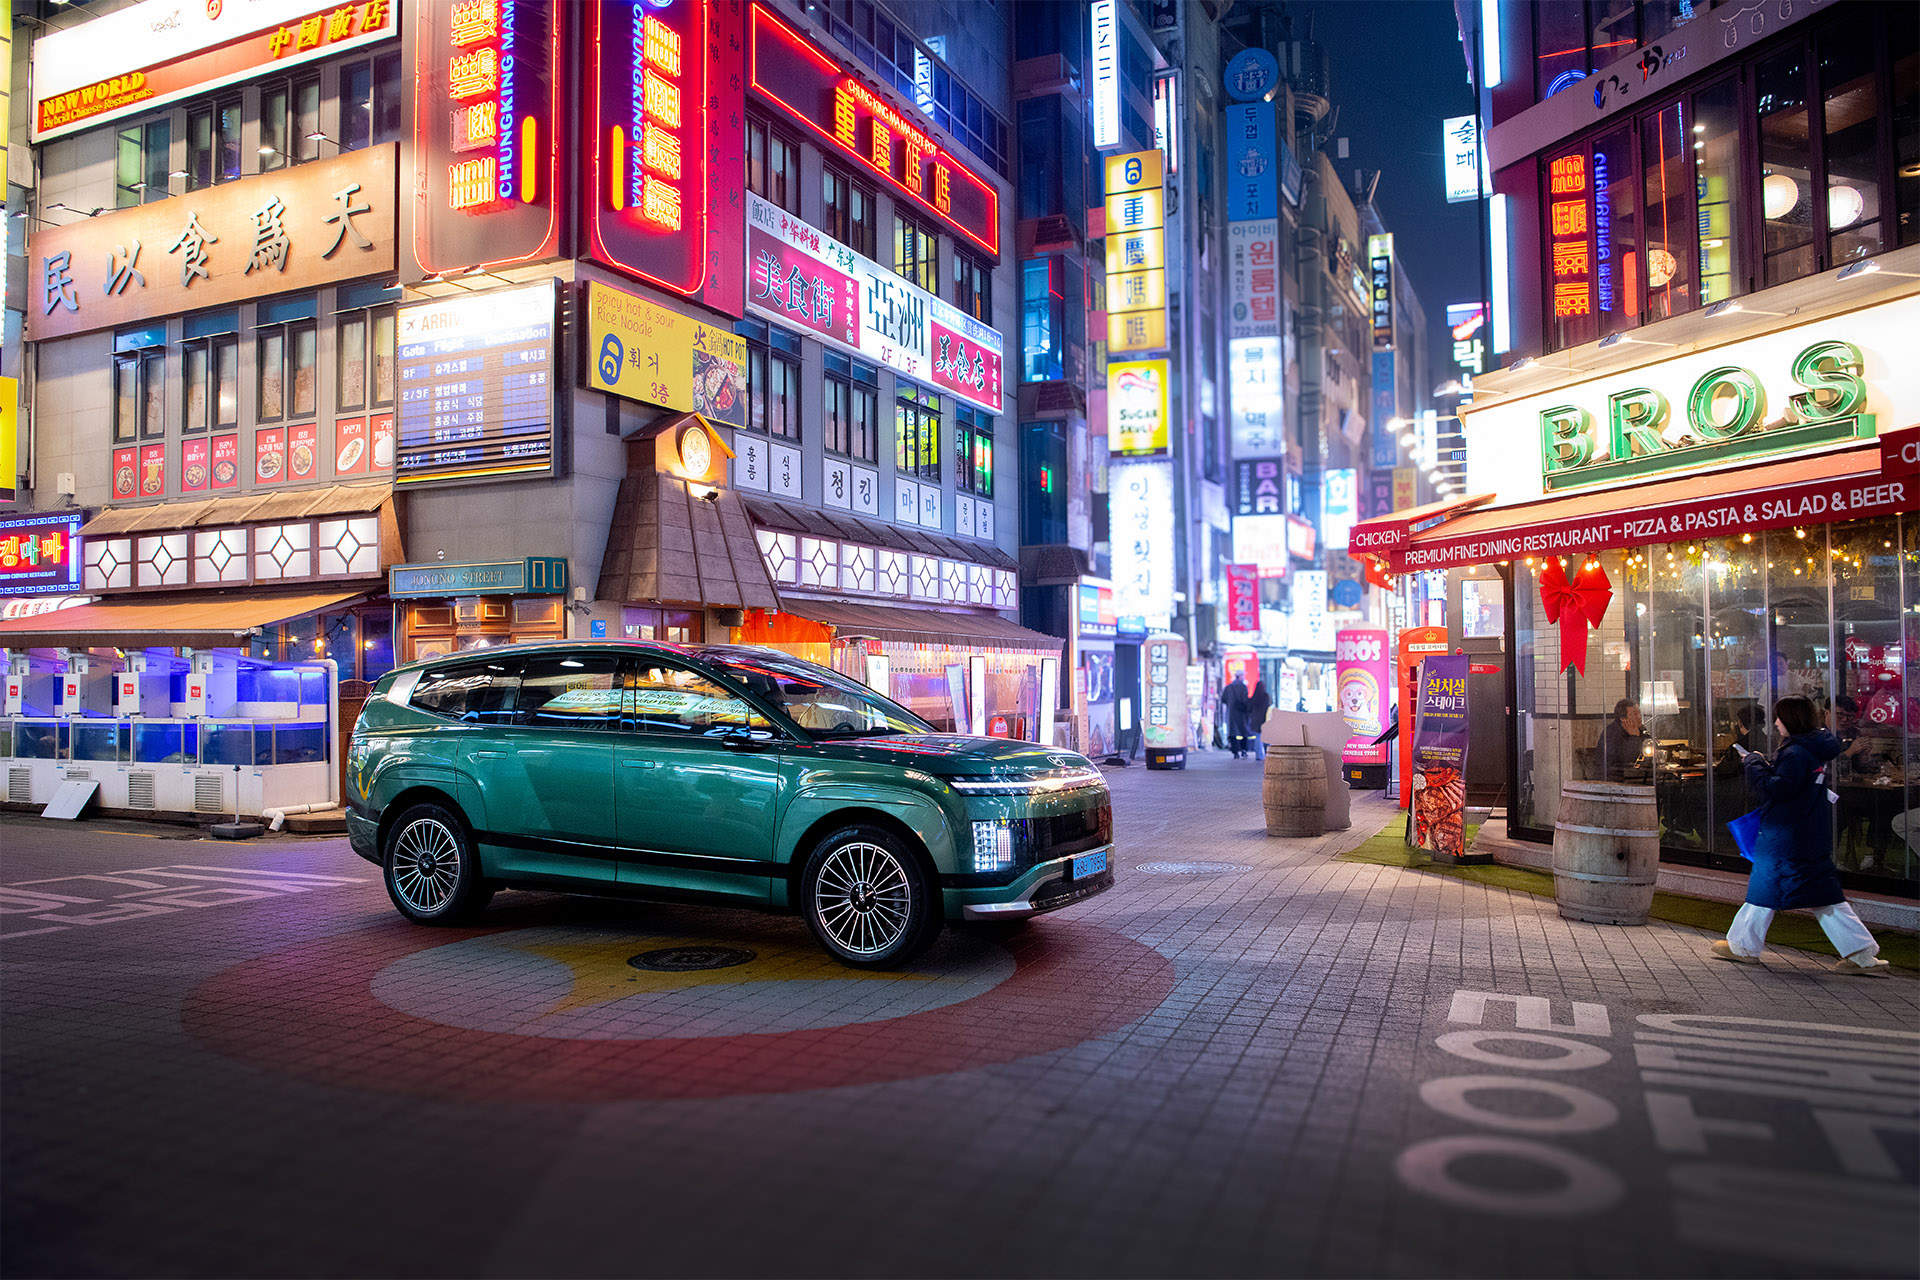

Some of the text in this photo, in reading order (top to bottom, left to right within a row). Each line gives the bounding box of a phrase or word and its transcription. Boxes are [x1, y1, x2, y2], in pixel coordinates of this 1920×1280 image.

[269, 0, 387, 58] 中國飯店
[79, 72, 146, 107] WORLD
[631, 3, 644, 208] CHUNGKING MAMA
[499, 55, 515, 198] CHUNGKING
[755, 250, 836, 330] 美食街
[596, 291, 623, 313] spicy
[626, 297, 642, 318] hot
[655, 312, 676, 329] sour
[597, 305, 653, 338] Rice Noodle
[866, 271, 925, 358] 亞洲
[402, 344, 426, 358] Gate
[881, 344, 893, 364] 2F
[906, 356, 918, 375] 3F
[1355, 528, 1401, 548] CHICKEN
[1404, 548, 1454, 566] PREMIUM
[1453, 543, 1479, 560] FINE
[1479, 536, 1522, 558] DINING
[1523, 523, 1613, 552] RESTAURANT
[1623, 517, 1667, 539] PIZZA
[1669, 515, 1683, 533] &
[1685, 507, 1741, 531] PASTA
[1743, 503, 1759, 523] &
[1761, 492, 1828, 521] SALAD
[1830, 490, 1848, 512] &
[1850, 481, 1906, 509] BEER
[462, 569, 505, 584] STREET
[1336, 640, 1382, 662] BROS
[1424, 696, 1466, 711] 스테이크
[1426, 678, 1466, 697] 살치살
